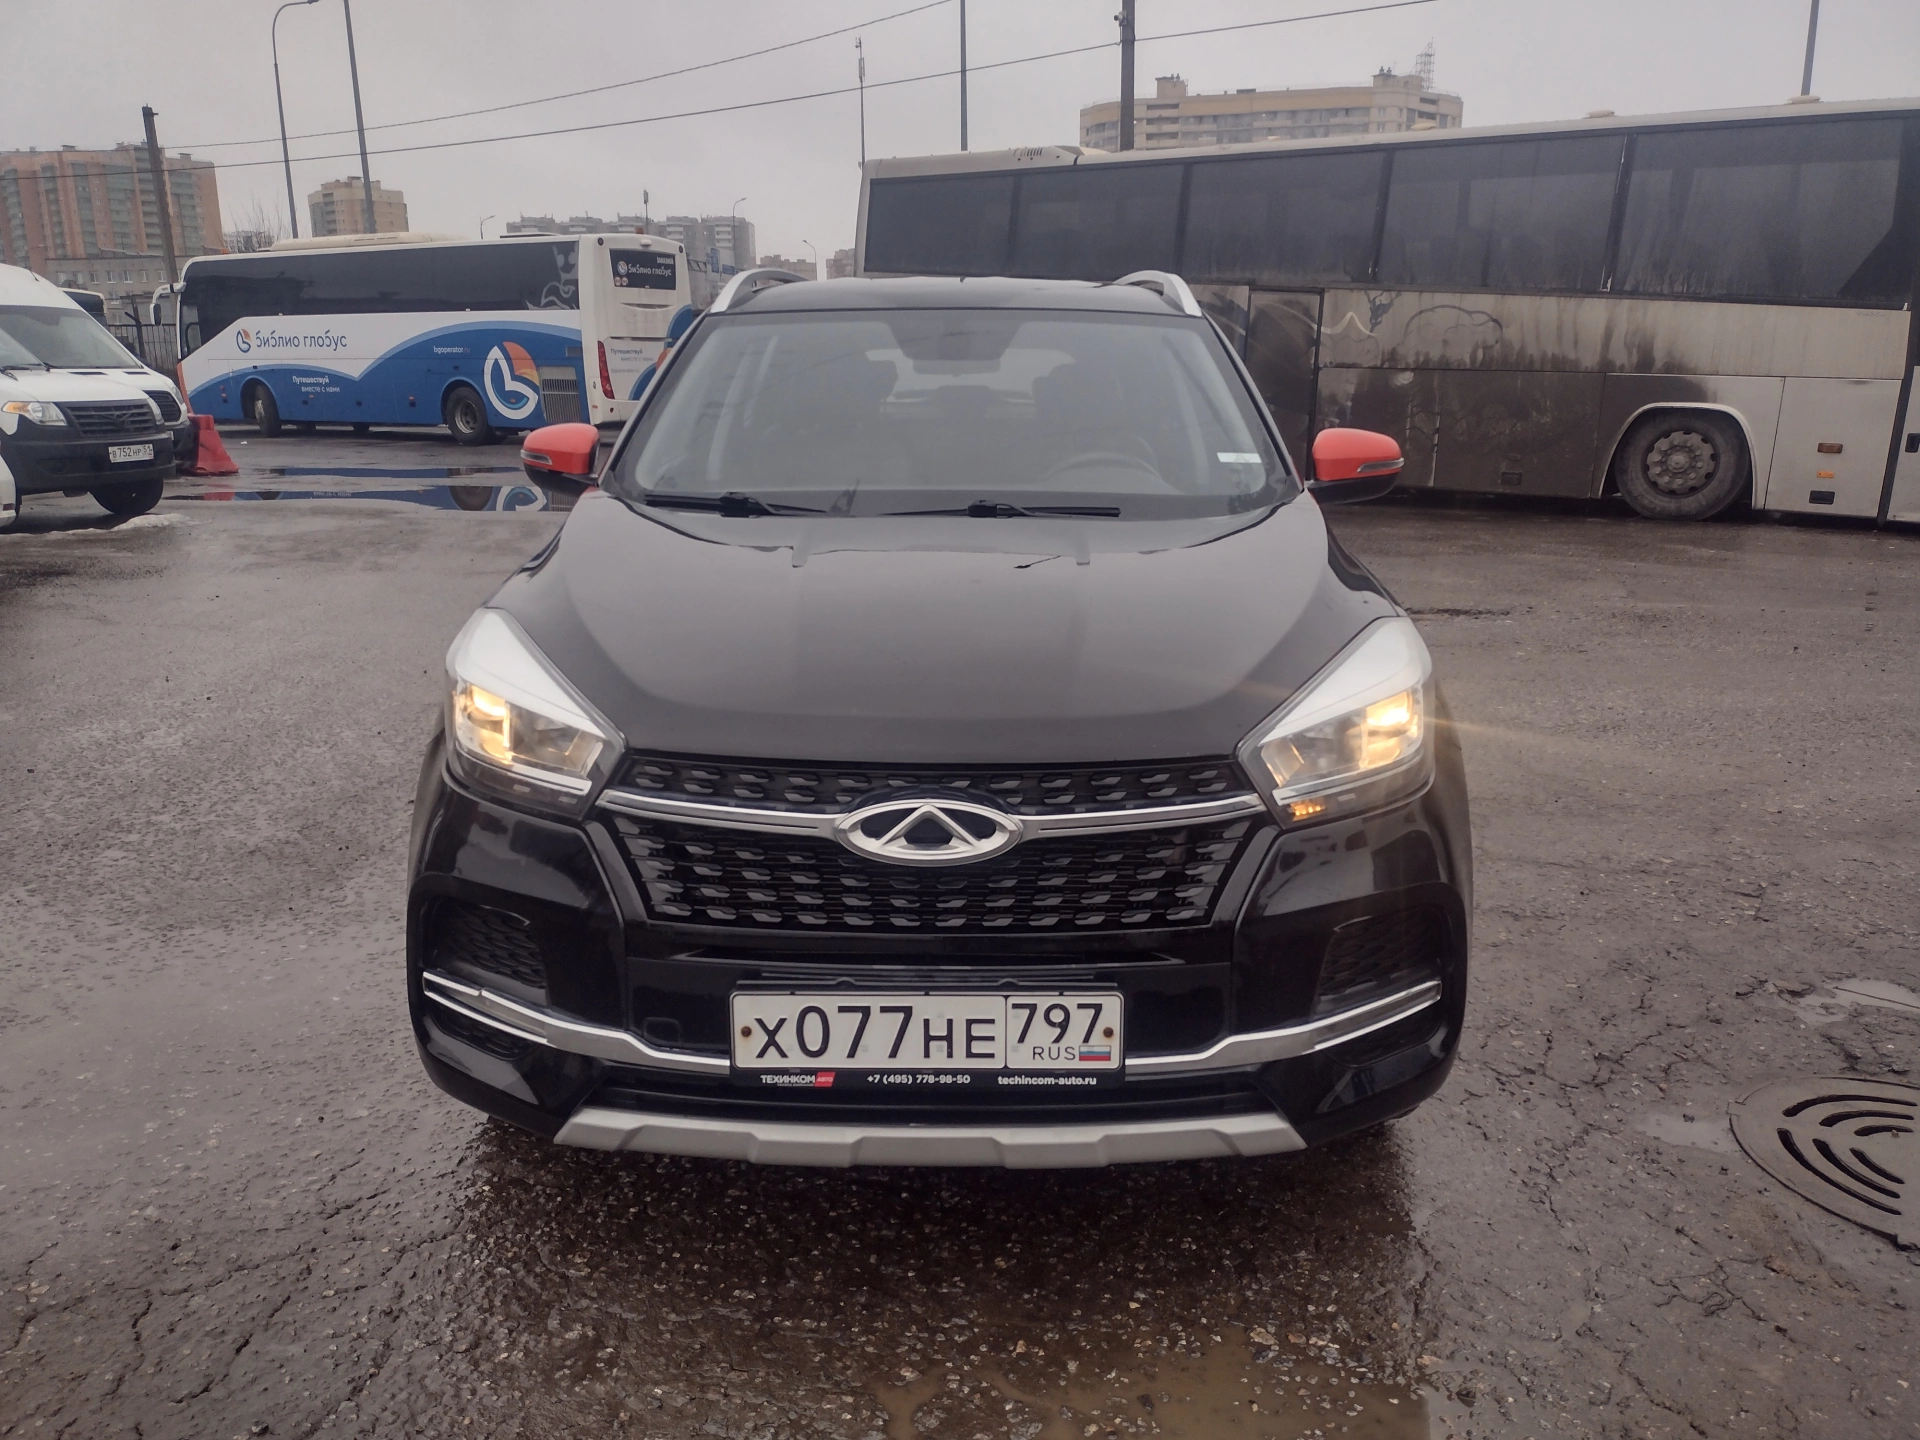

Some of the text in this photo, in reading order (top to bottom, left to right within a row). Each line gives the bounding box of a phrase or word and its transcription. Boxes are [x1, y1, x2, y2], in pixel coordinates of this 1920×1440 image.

[255, 329, 348, 352] библио глобус
[292, 375, 330, 385] Путешествуй
[1010, 1002, 1104, 1045] 797
[1032, 1045, 1076, 1062] RUS
[760, 1074, 816, 1084] ТЕХИНКОМ
[866, 1073, 971, 1085] +7 (495) 778-98-50
[997, 1074, 1097, 1086] techincom-auto.ru
